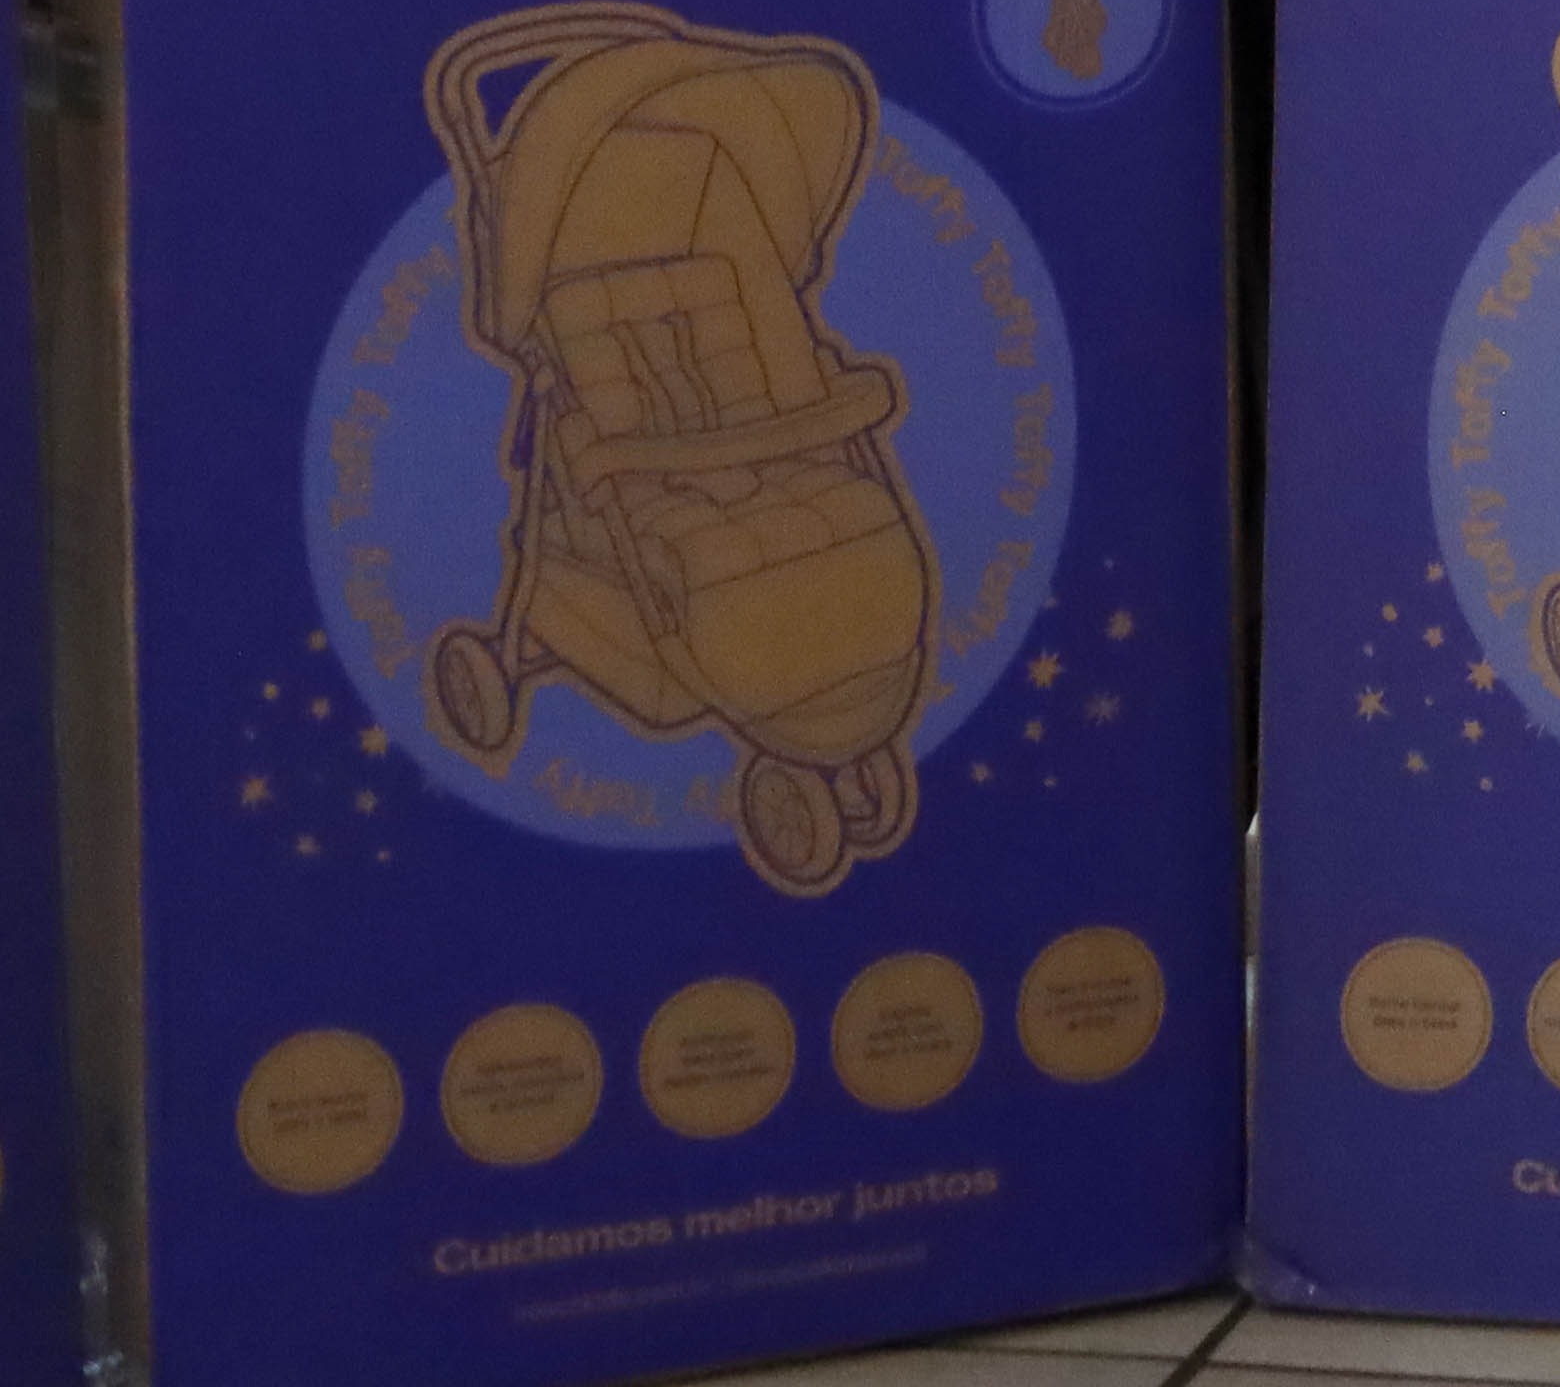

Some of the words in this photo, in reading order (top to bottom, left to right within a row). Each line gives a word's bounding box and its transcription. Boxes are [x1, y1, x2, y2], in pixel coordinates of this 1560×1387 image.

[1451, 338, 1514, 469] Toffy
[434, 1216, 673, 1275] Cuidamos
[684, 1191, 842, 1238] melhor
[851, 1168, 997, 1221] juntos
